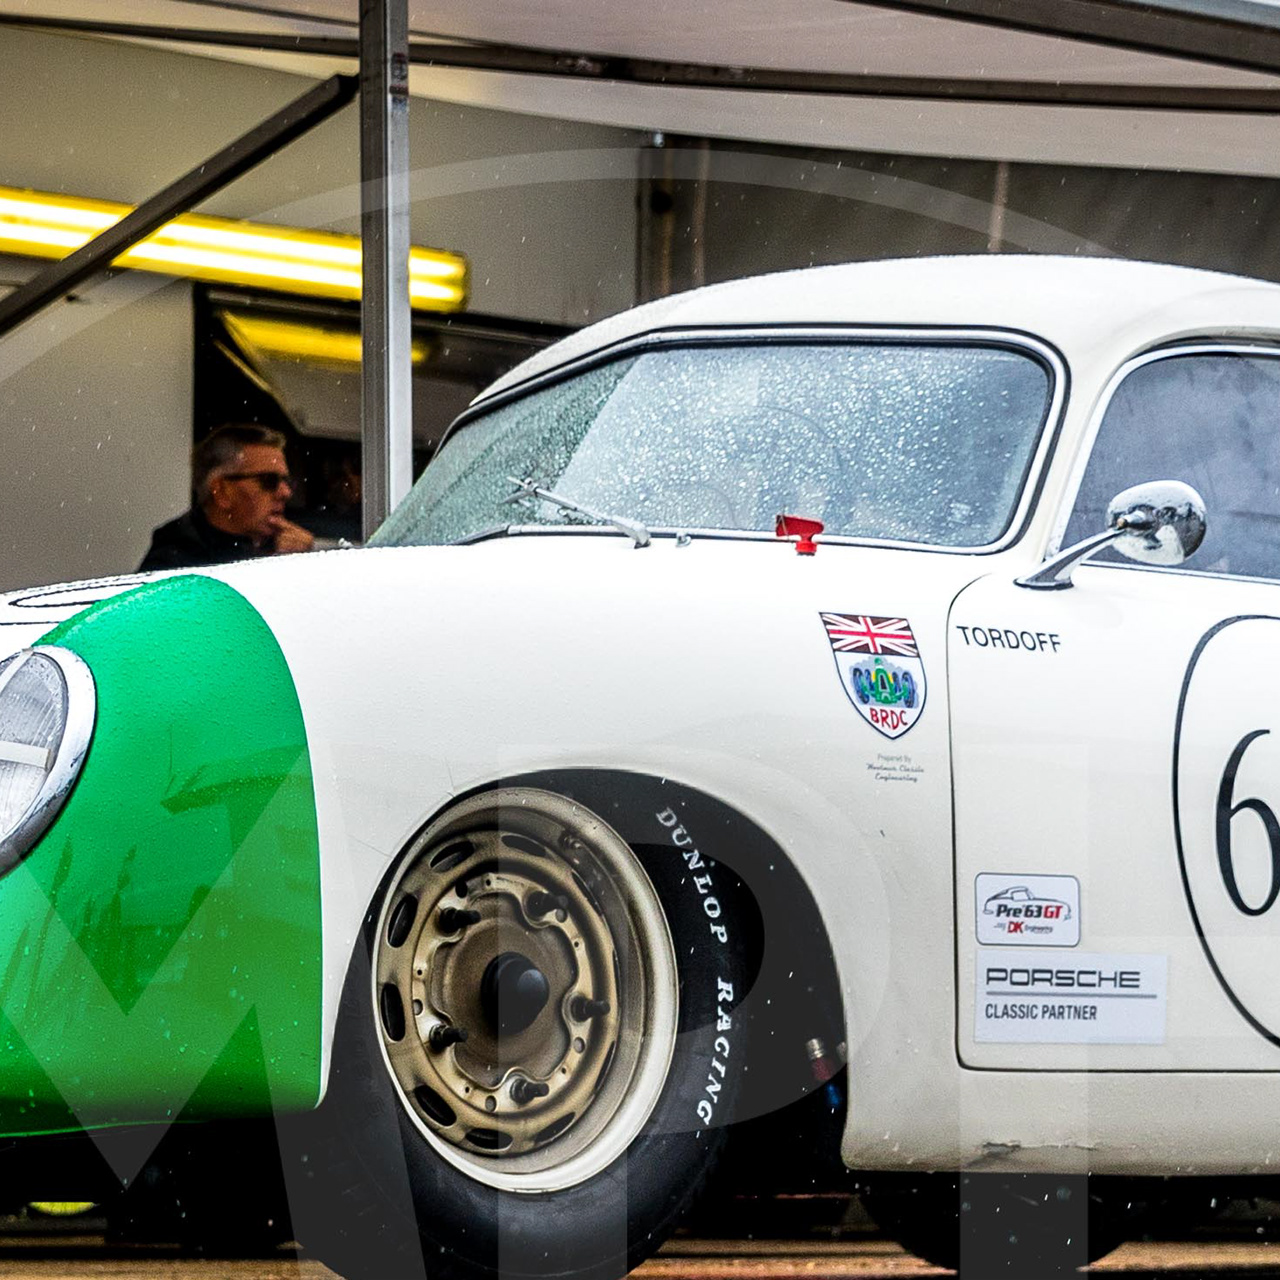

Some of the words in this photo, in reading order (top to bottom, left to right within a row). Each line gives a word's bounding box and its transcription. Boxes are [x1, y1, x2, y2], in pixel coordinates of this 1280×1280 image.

[956, 625, 1061, 653] TORDOFF
[870, 707, 908, 730] BRDC
[1007, 921, 1024, 933] DK
[656, 807, 728, 944] DUNLOP
[696, 976, 734, 1126] RACING
[986, 968, 1140, 988] PORSCHE
[985, 1003, 1038, 1019] CLASSIC
[1041, 1005, 1097, 1020] PARTNER
